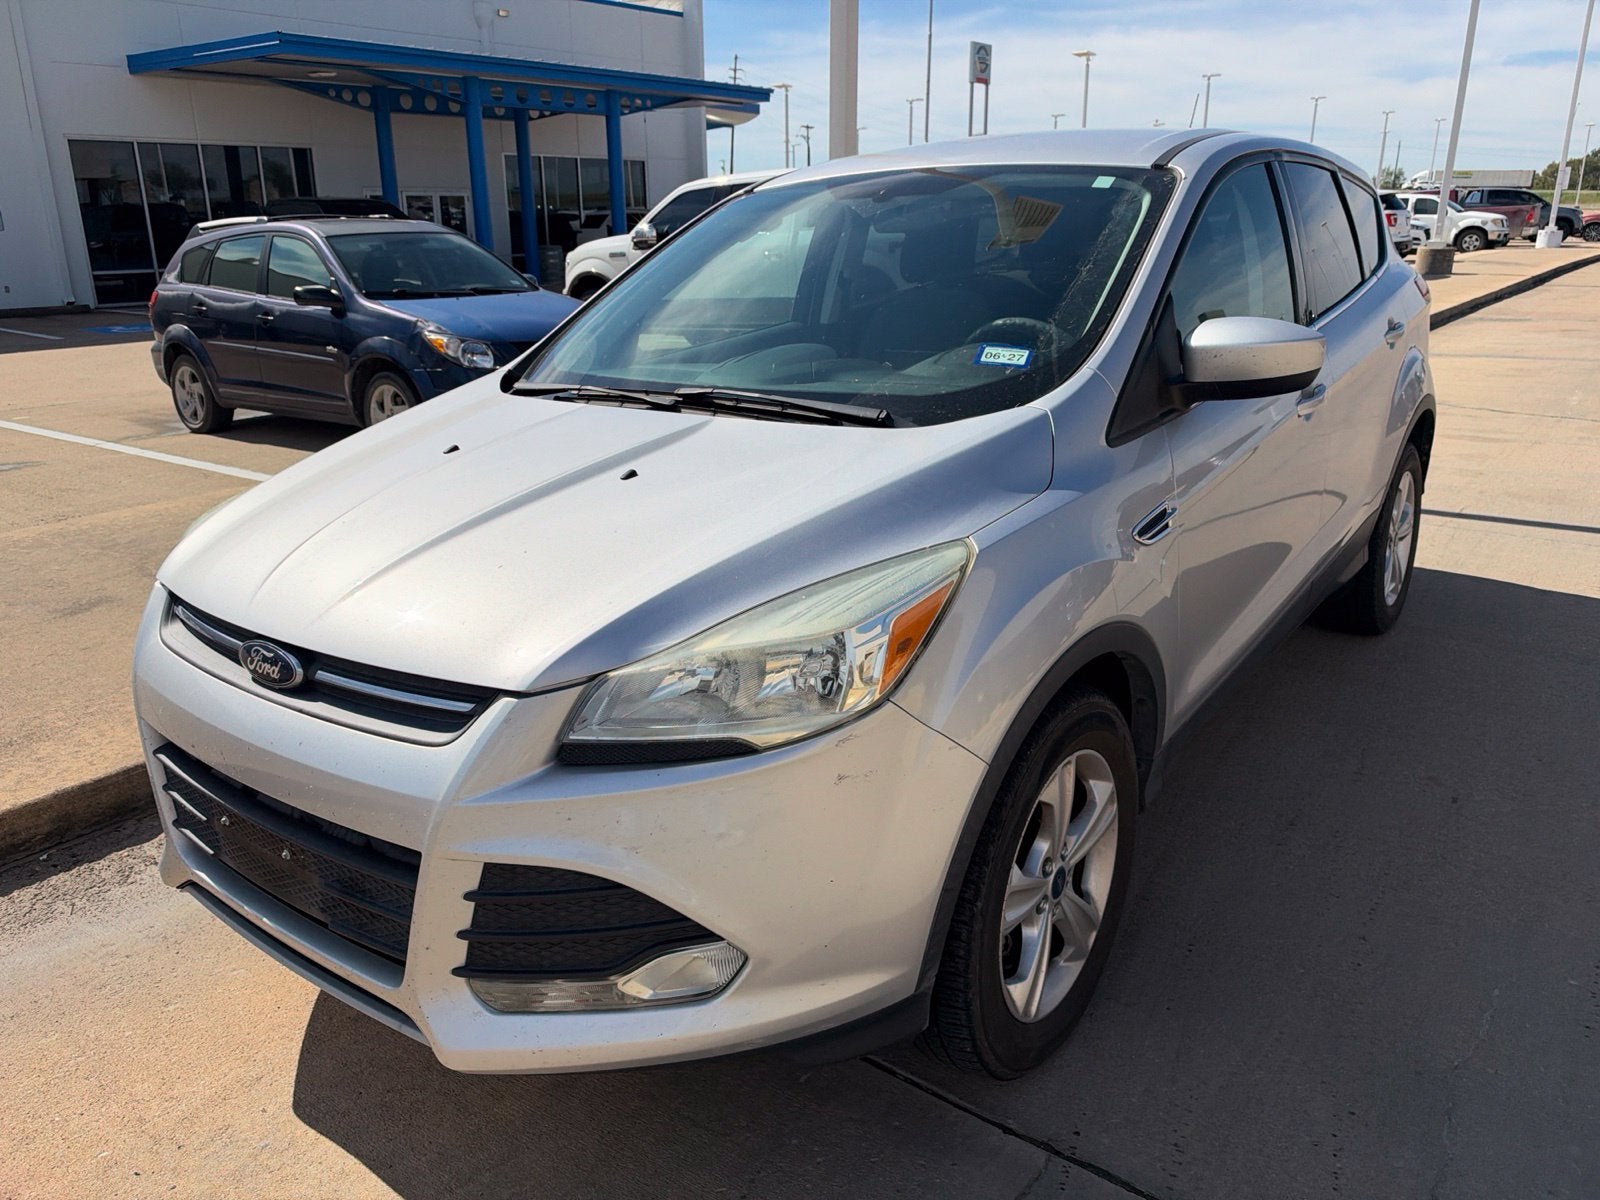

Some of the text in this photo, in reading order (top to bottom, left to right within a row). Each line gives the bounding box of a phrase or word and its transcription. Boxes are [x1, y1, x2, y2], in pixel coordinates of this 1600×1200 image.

[984, 351, 1001, 360] 06
[1007, 353, 1025, 362] 27
[247, 646, 281, 679] Ford
